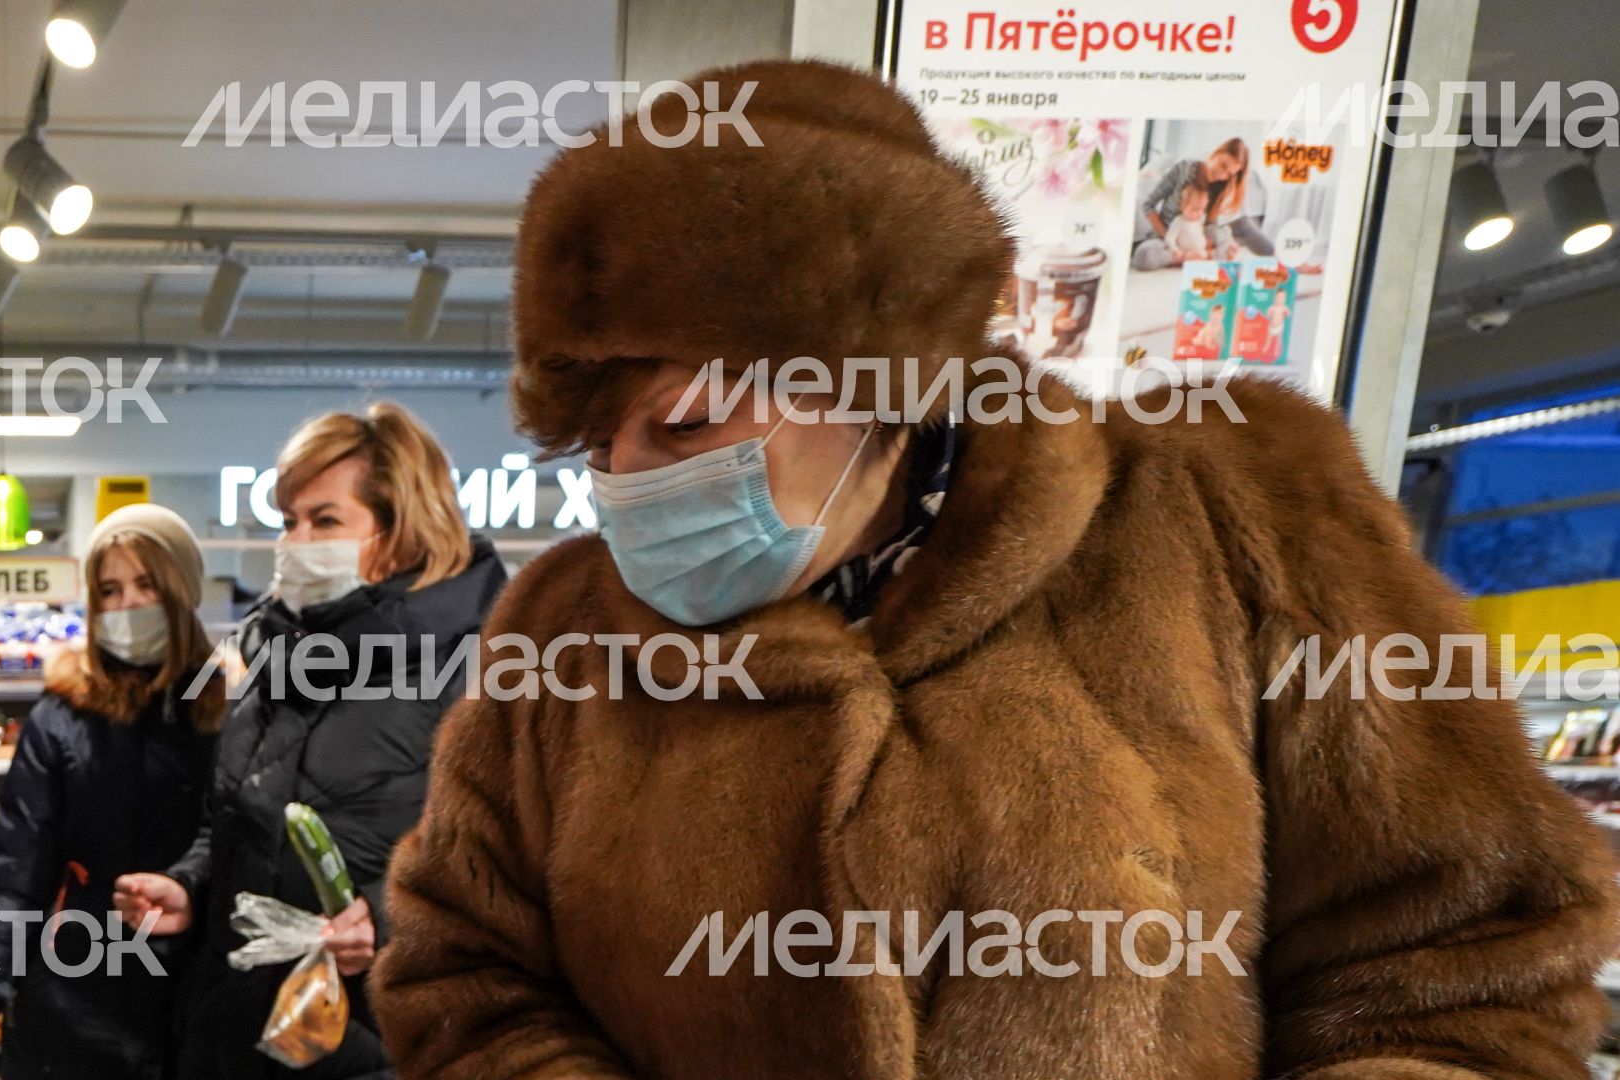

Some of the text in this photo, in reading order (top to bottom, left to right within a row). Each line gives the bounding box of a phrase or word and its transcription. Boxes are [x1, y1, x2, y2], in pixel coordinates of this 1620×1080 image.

[924, 8, 1237, 62] в Пятёрочке!
[919, 89, 938, 106] 19
[959, 89, 980, 106] 25
[985, 92, 1059, 110] января
[1266, 142, 1333, 170] Honey
[1283, 165, 1310, 181] Kid
